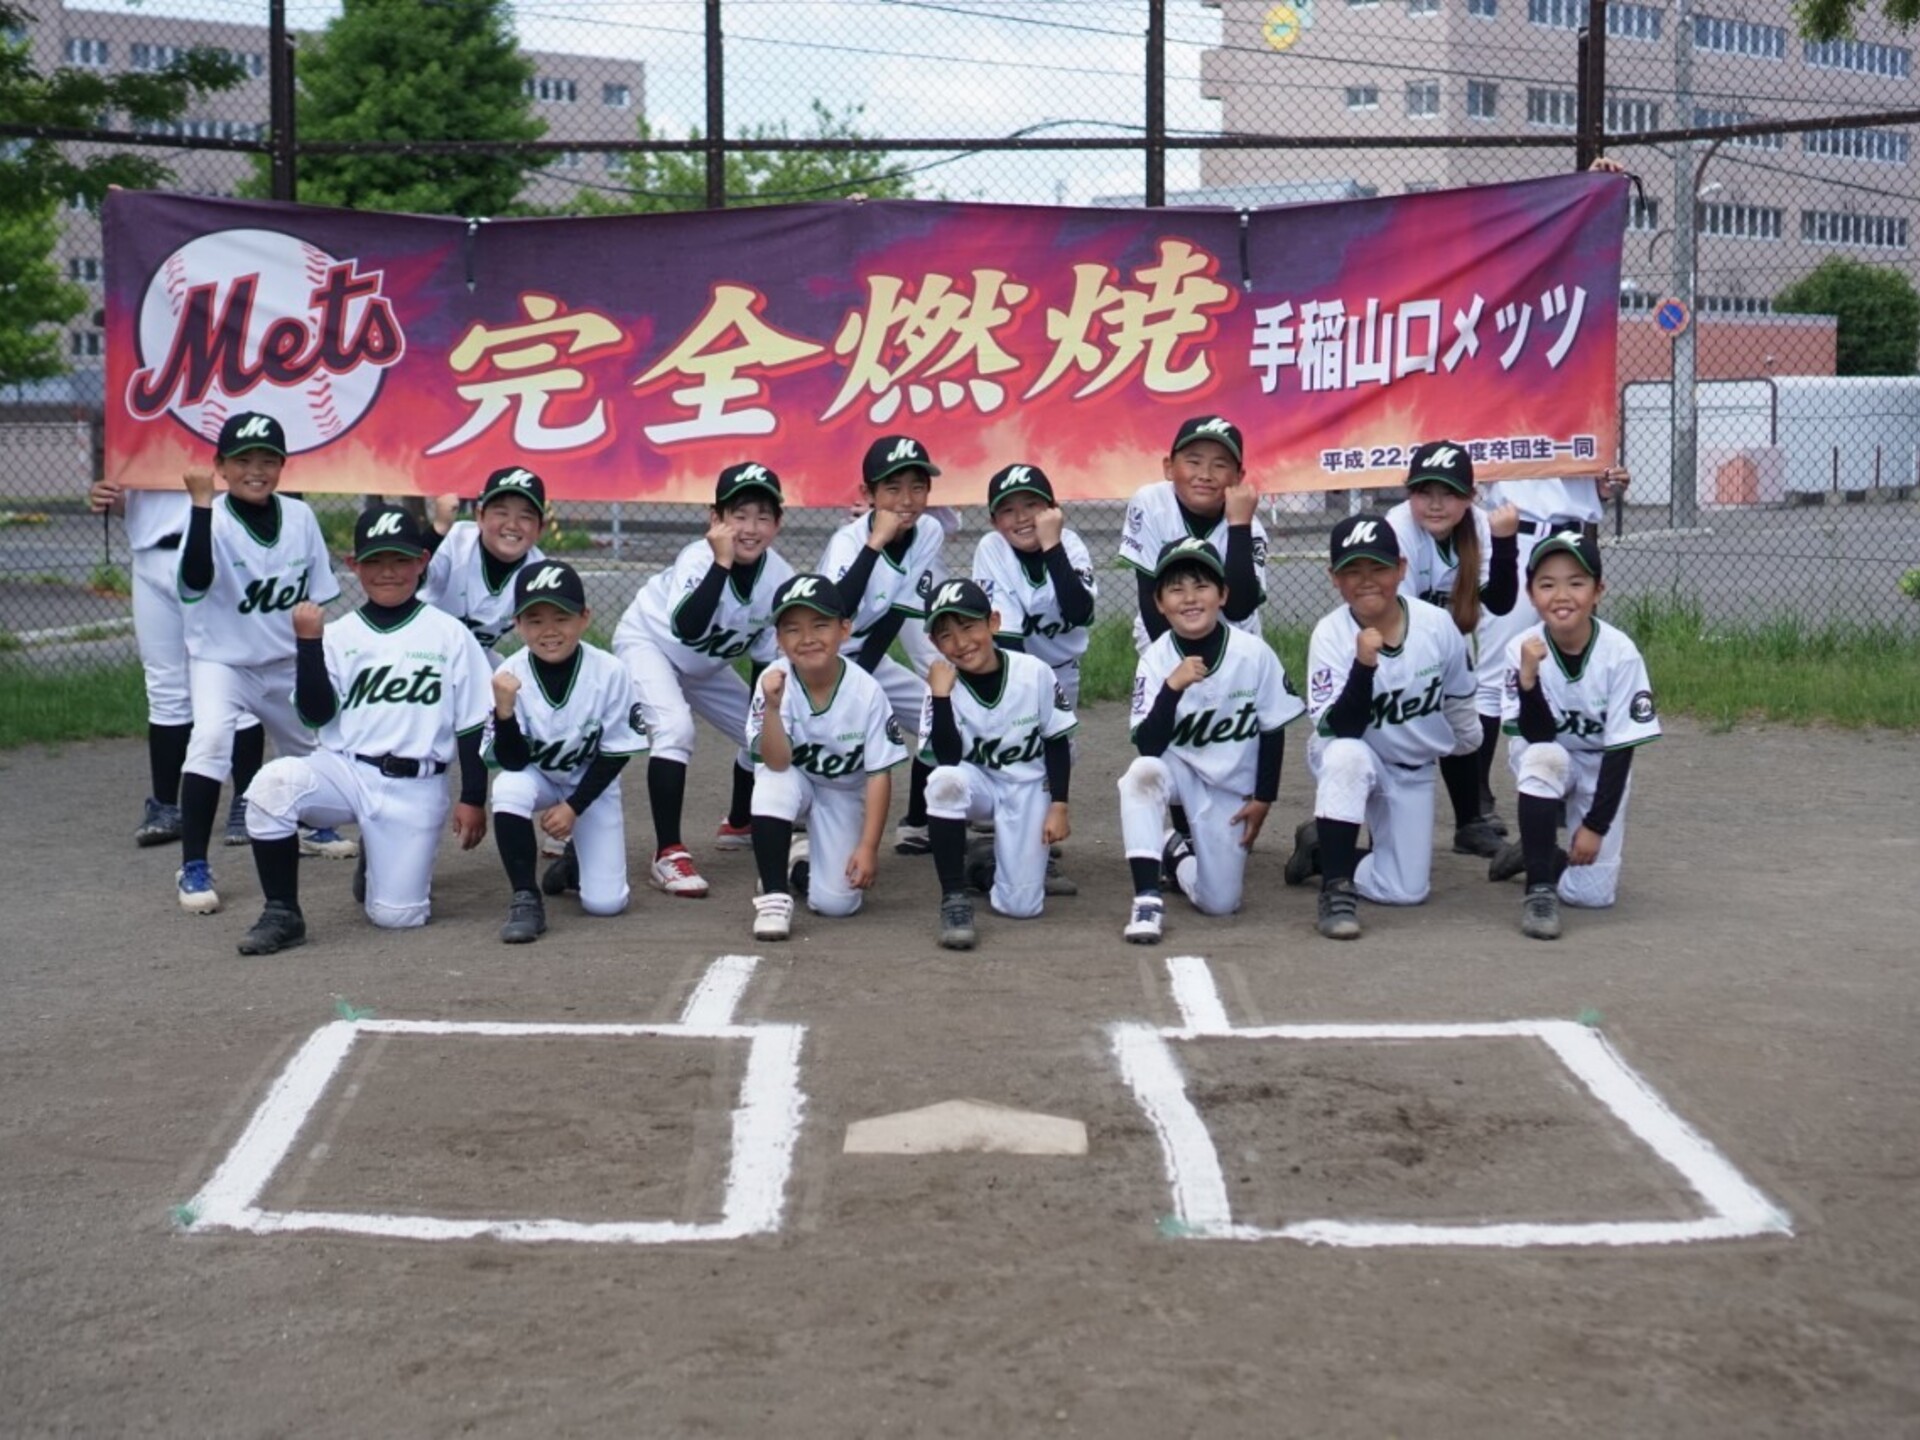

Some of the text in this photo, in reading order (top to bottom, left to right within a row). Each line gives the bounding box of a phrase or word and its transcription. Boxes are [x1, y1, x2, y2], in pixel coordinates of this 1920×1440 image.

[127, 259, 404, 420] Mets
[424, 240, 1230, 457] 完全燃焼
[1249, 284, 1587, 394] 手稲山口メッツ
[236, 416, 270, 438] M
[886, 438, 918, 462] M
[1322, 450, 1365, 472] 平成
[1466, 436, 1595, 463] 度卒団生一同
[1421, 446, 1460, 469] M
[498, 468, 535, 488] M
[735, 463, 768, 483] M
[1000, 465, 1031, 489] M
[366, 512, 403, 538] M
[1341, 520, 1378, 548] M
[237, 565, 309, 615] Met
[526, 566, 564, 592] M
[782, 577, 819, 602] M
[931, 582, 964, 611] M
[341, 664, 442, 711] Mets
[1370, 676, 1442, 730] Met
[528, 734, 601, 772] Met
[791, 742, 865, 780] Met
